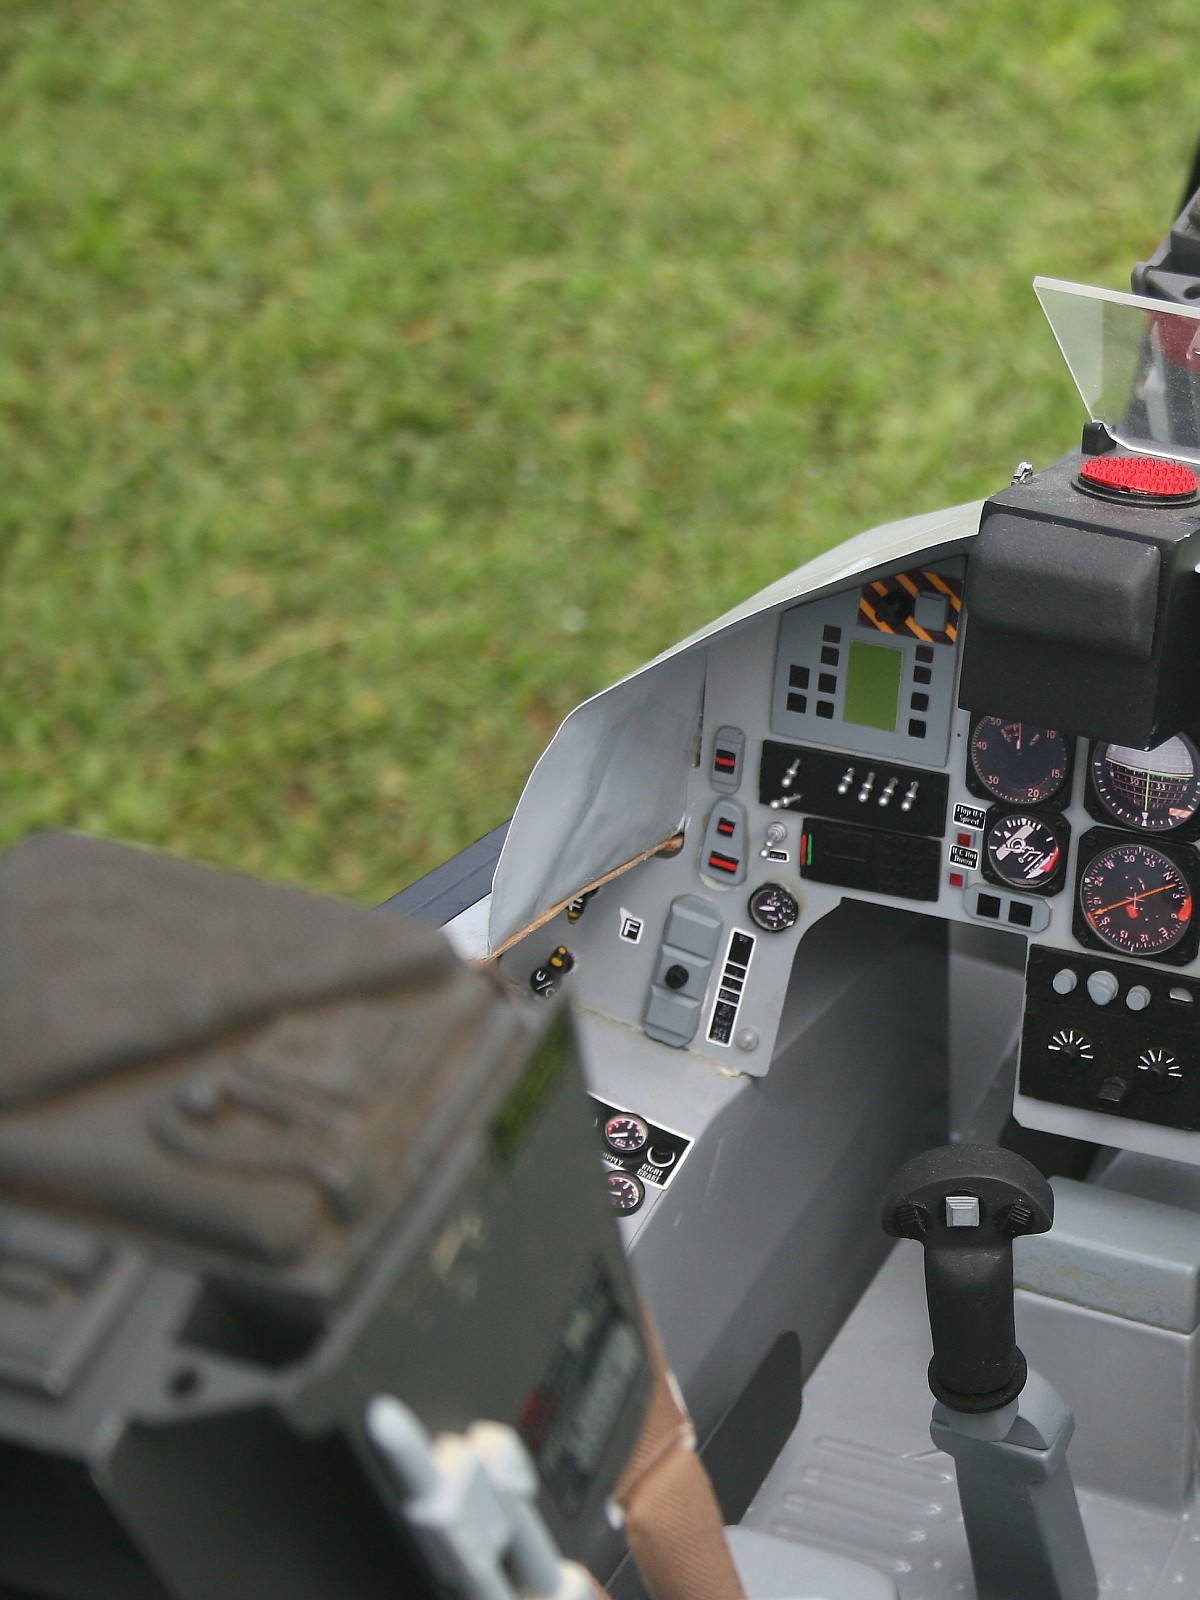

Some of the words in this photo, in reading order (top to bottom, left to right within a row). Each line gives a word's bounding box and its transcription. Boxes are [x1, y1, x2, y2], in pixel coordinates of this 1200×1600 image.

[1047, 730, 1056, 738] 10
[976, 742, 988, 750] 40
[1052, 769, 1060, 778] 15
[987, 775, 998, 784] 30
[1027, 788, 1040, 798] 20
[1124, 855, 1136, 863] 30
[1144, 858, 1156, 868] 33
[1104, 860, 1115, 870] W
[1162, 871, 1172, 881] N
[1094, 876, 1104, 887] 24
[1100, 916, 1110, 926] S
[624, 920, 640, 936] F
[1158, 927, 1169, 938] E
[1120, 930, 1128, 938] 15
[1140, 934, 1148, 942] 12
